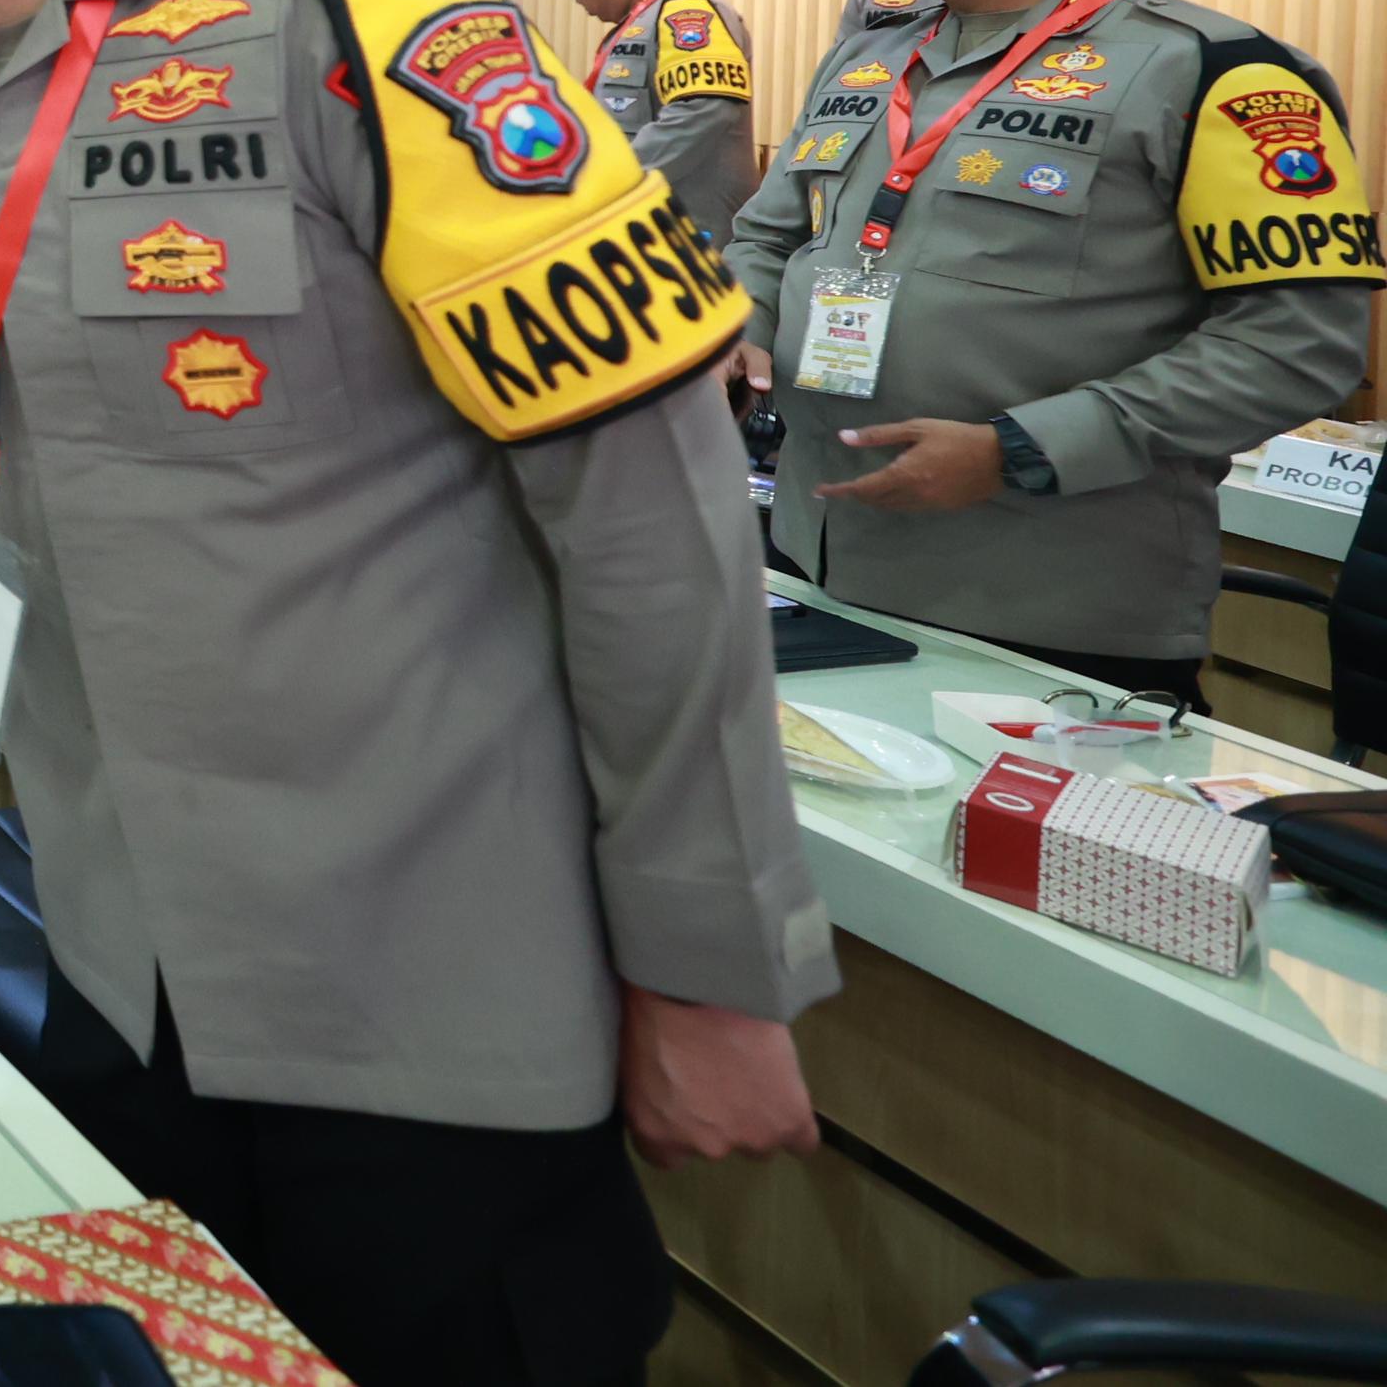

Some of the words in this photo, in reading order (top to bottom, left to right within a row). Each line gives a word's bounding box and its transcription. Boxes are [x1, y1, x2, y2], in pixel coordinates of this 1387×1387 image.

[416, 15, 510, 70] POLRES
[658, 61, 747, 96] KAOPSRES
[814, 95, 879, 119] ARGO
[976, 108, 1094, 145] POLRI
[84, 133, 268, 189] POLRI
